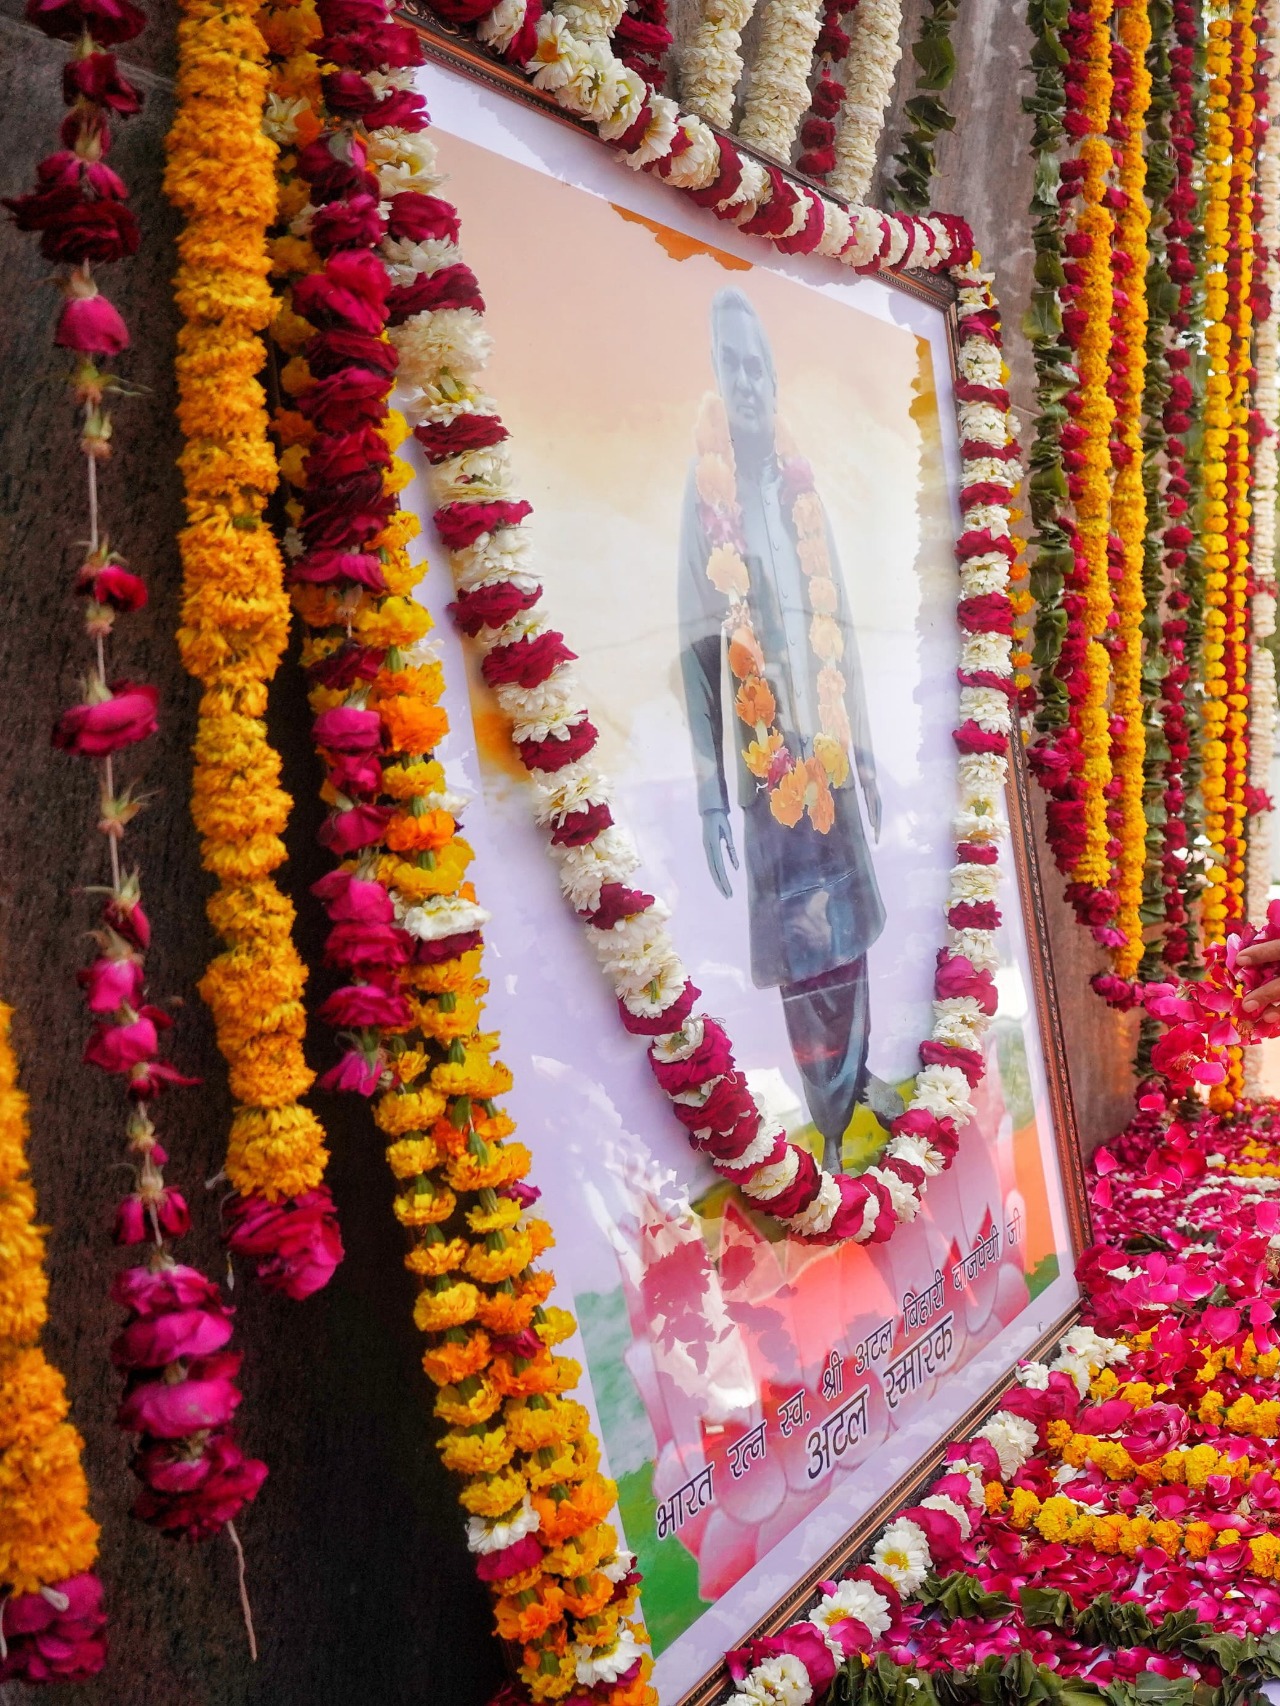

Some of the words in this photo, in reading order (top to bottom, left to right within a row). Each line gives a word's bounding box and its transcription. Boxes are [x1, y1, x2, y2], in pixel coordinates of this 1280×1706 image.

[656, 1463, 714, 1539] भारत
[728, 1421, 766, 1478] रत्न
[778, 1390, 810, 1437] स्व.
[824, 1350, 843, 1400] श्री
[856, 1318, 893, 1374] अटल
[903, 1269, 944, 1335] बिहारी
[952, 1225, 999, 1290] बाजपेयी
[1006, 1207, 1021, 1245] जी
[807, 1388, 868, 1480] अटल
[883, 1315, 953, 1408] स्मारक
